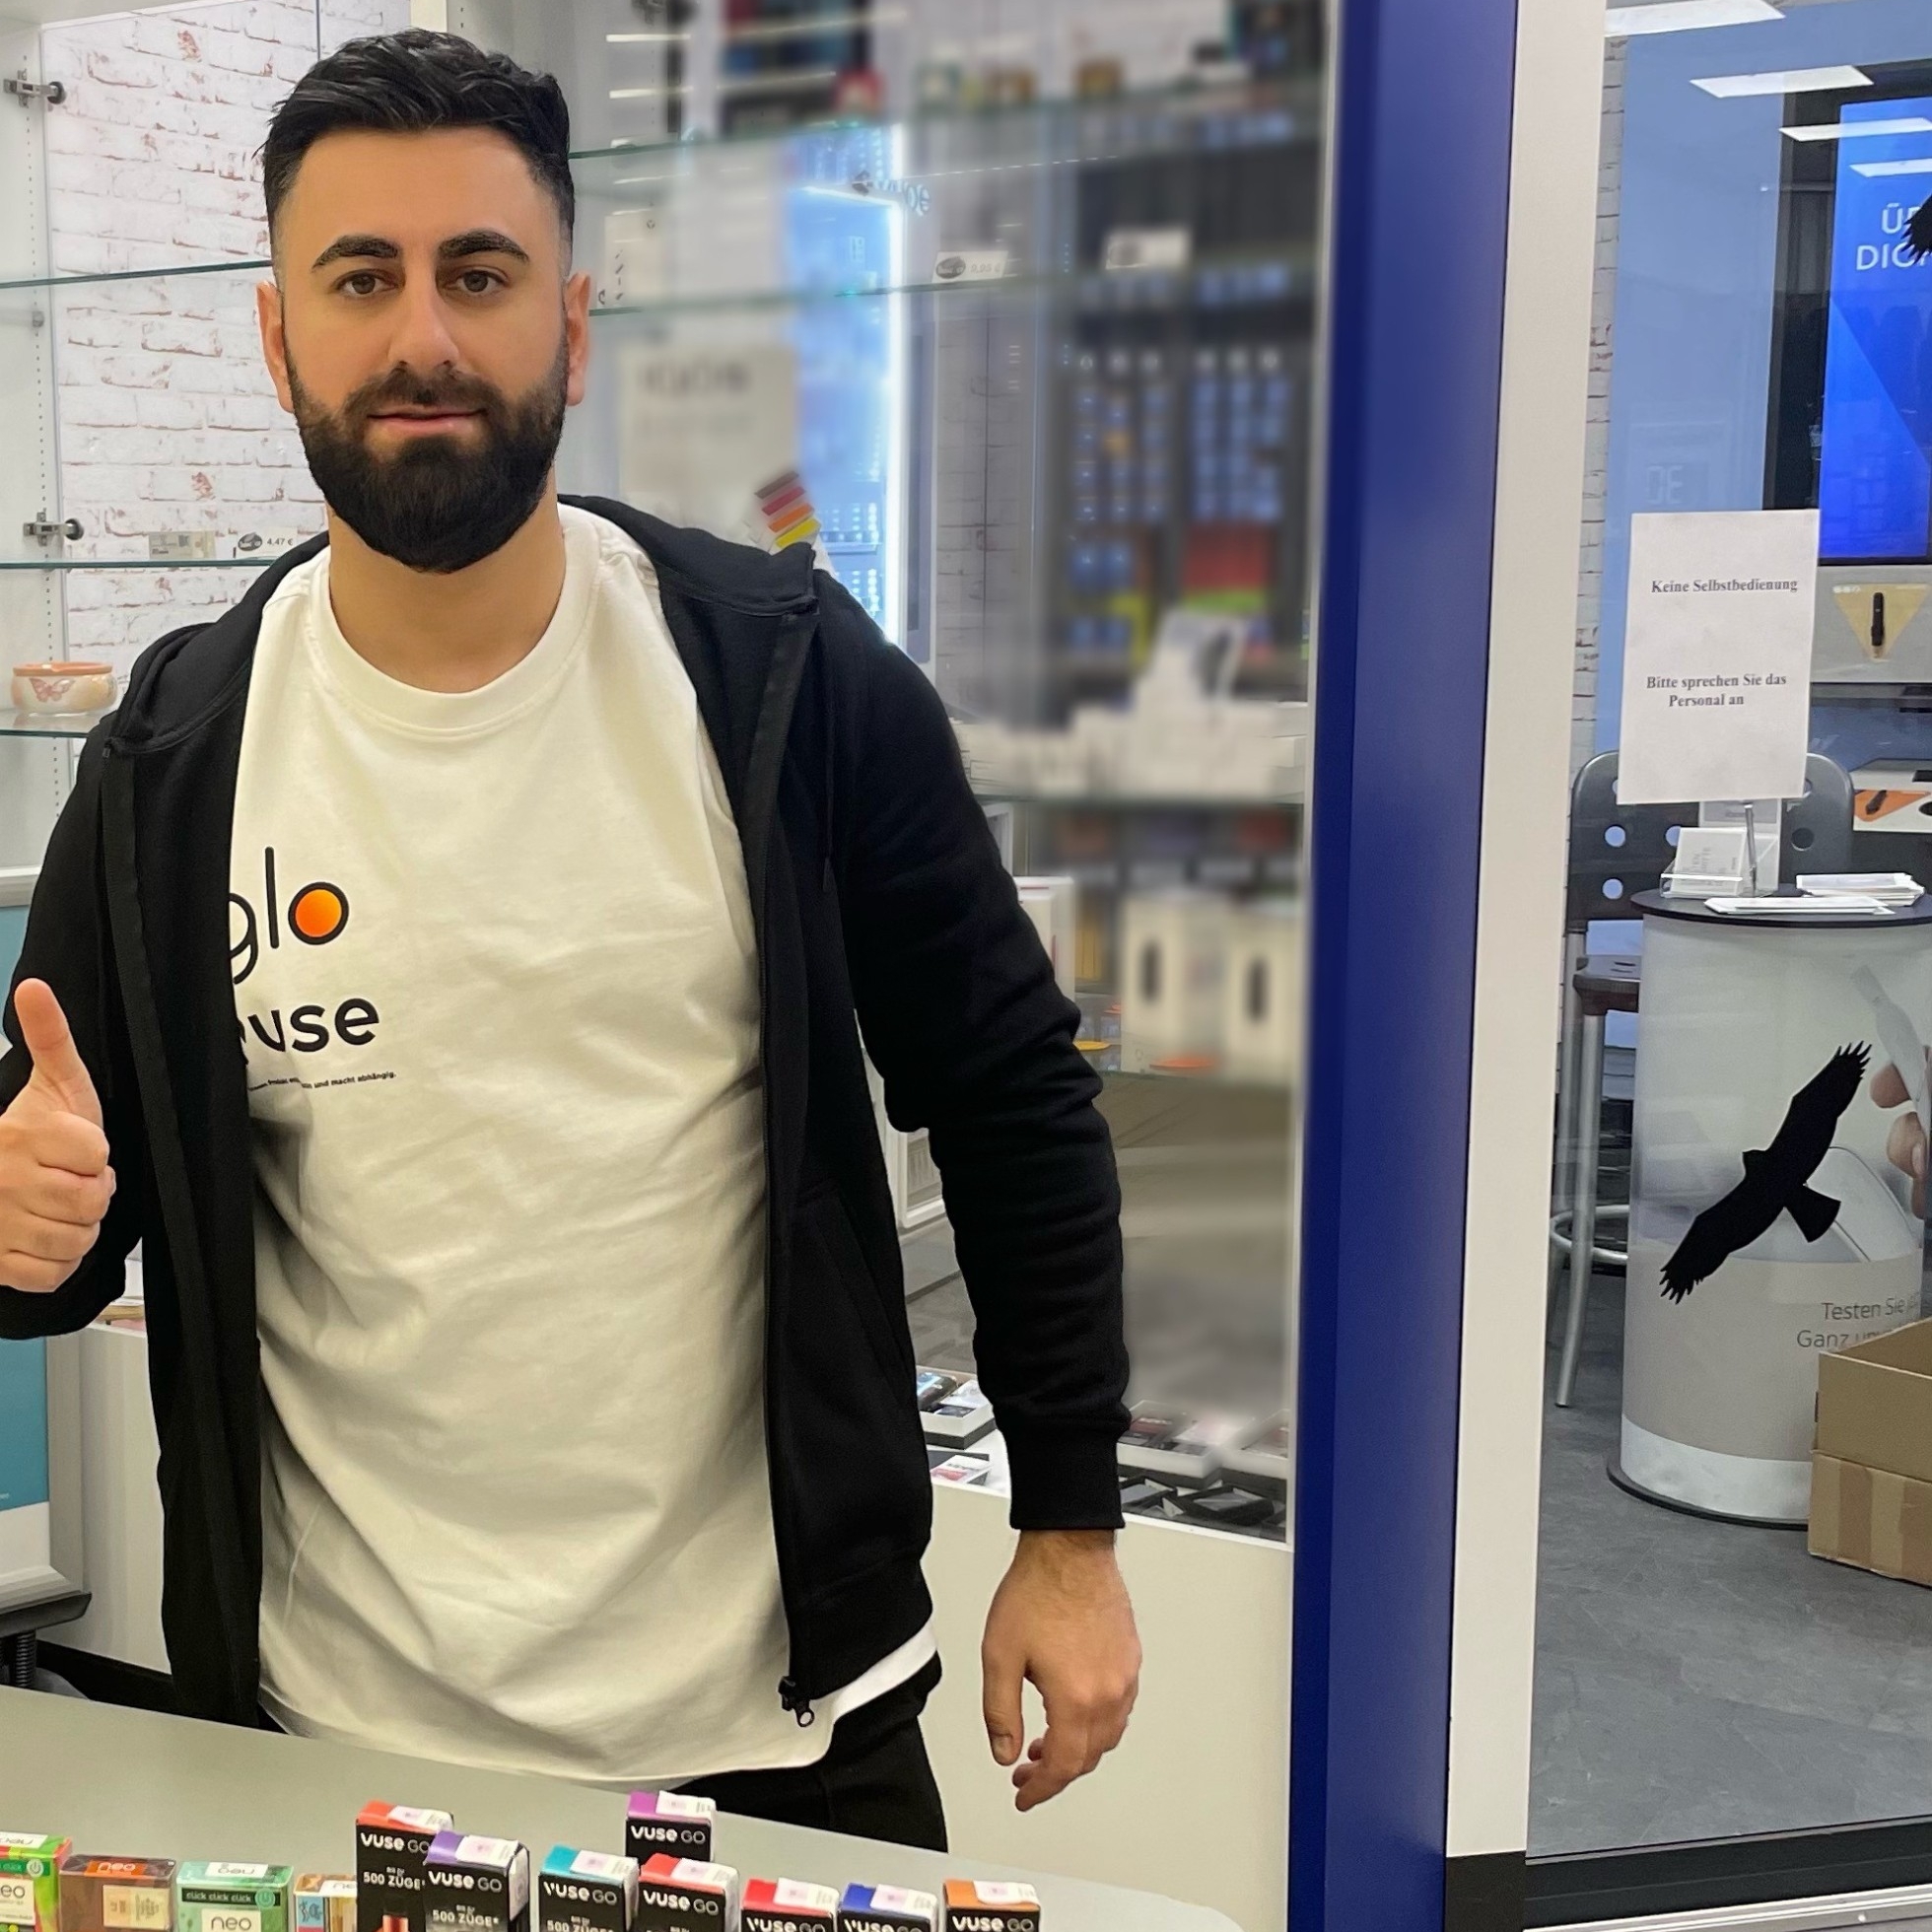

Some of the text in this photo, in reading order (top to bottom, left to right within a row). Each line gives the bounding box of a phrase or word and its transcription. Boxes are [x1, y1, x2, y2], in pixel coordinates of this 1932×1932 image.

[1651, 579, 1799, 592] Keine Selbstbedienung
[1647, 673, 1786, 690] Bitte sprechen Sie das
[1669, 693, 1745, 707] Personal an
[238, 998, 380, 1055] use
[1822, 1301, 1881, 1320] Testen
[1885, 1297, 1905, 1316] Sie
[1797, 1330, 1850, 1347] Ganz
[680, 1829, 706, 1845] GO
[407, 1839, 430, 1854] GO
[363, 1871, 385, 1886] 500
[477, 1877, 503, 1893] GO
[0, 1885, 26, 1898] eo
[592, 1889, 617, 1905] GO
[693, 1898, 720, 1916] GO
[211, 1915, 252, 1931] neo
[432, 1909, 454, 1924] 500
[1006, 1918, 1035, 1932] GO
